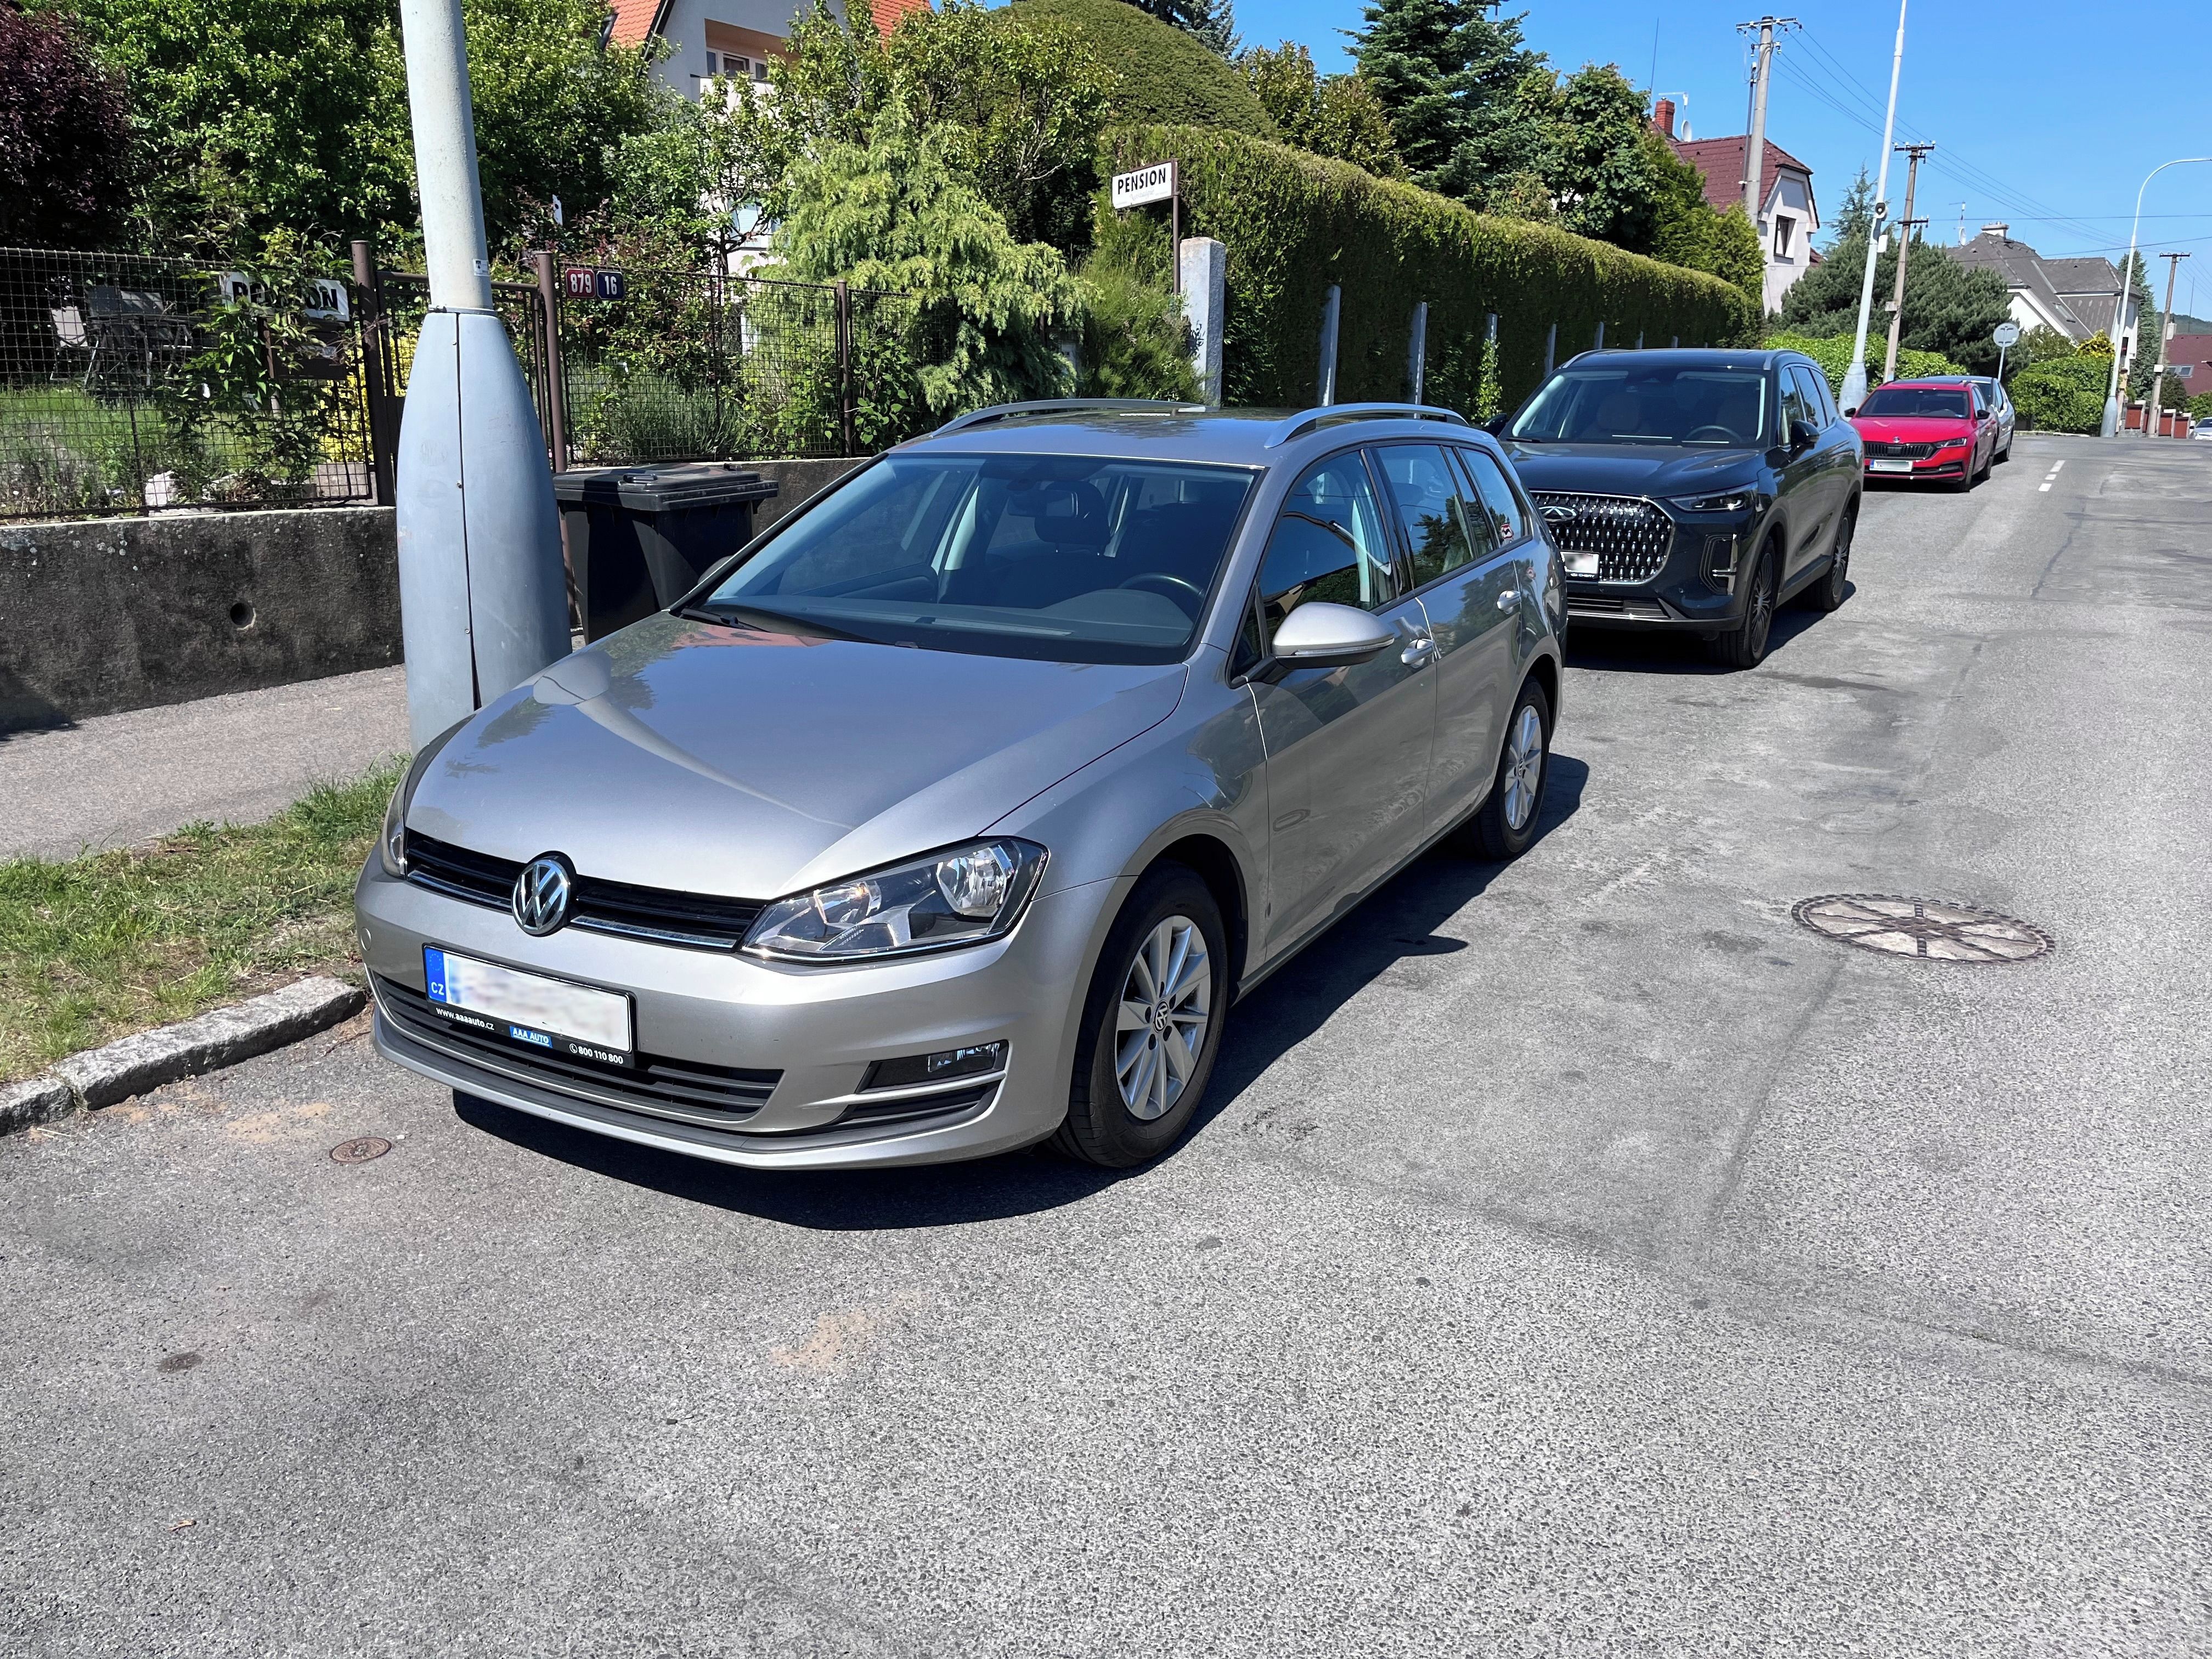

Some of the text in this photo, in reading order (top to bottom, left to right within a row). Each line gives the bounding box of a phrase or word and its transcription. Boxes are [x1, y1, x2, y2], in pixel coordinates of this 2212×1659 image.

[1118, 168, 1166, 194] PENSION
[570, 273, 592, 293] 879
[605, 275, 617, 295] 16
[232, 281, 338, 311] PEON
[516, 861, 568, 932] VW
[431, 981, 444, 995] CZ
[436, 1007, 494, 1030] www.aaaauto.cz
[513, 1028, 549, 1043] AAA AUTO
[578, 1046, 623, 1064] 800 110 800
